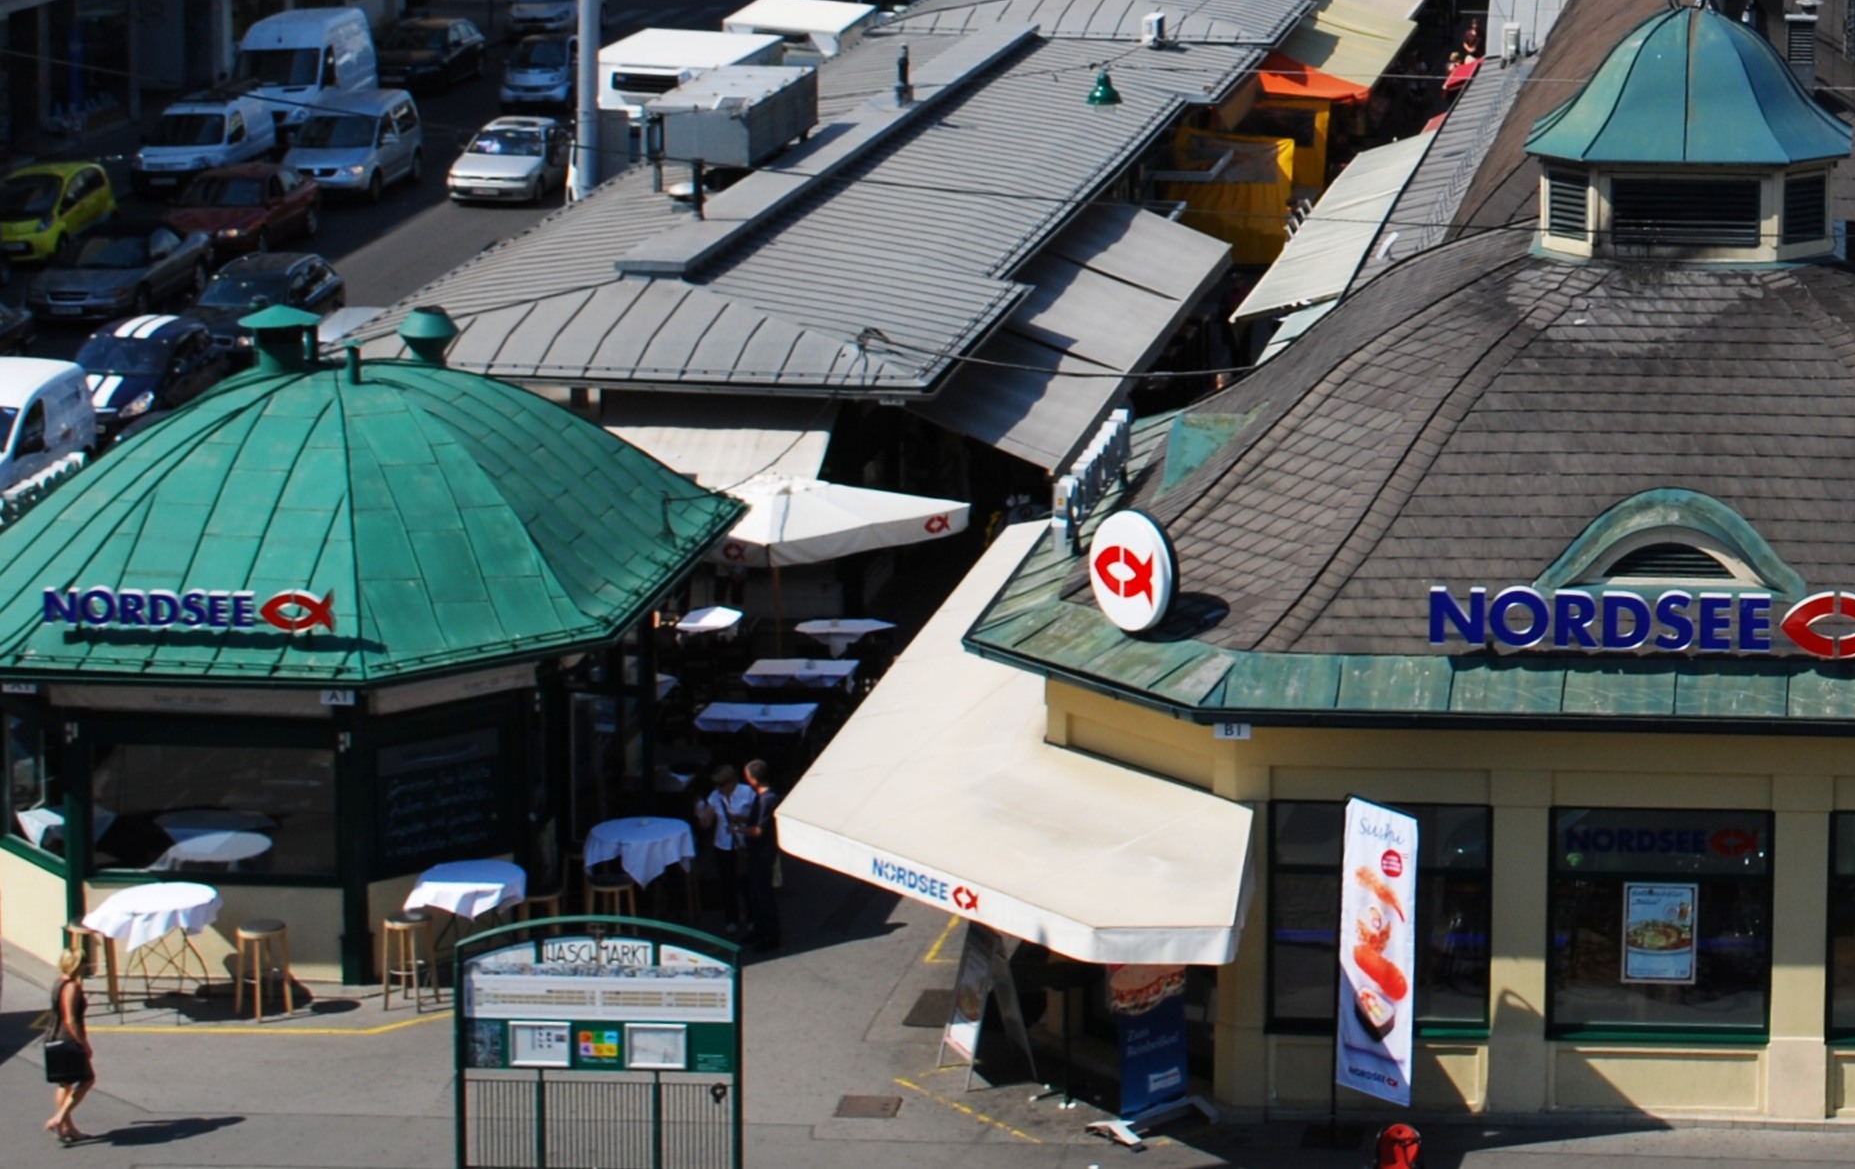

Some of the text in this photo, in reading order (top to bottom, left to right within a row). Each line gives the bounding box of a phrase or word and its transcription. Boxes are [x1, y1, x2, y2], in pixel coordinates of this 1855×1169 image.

[42, 585, 256, 629] NORDSEE
[1428, 585, 1772, 651] NORDSEE
[1566, 828, 1707, 853] NORDSEE
[872, 857, 949, 901] NORDSEE
